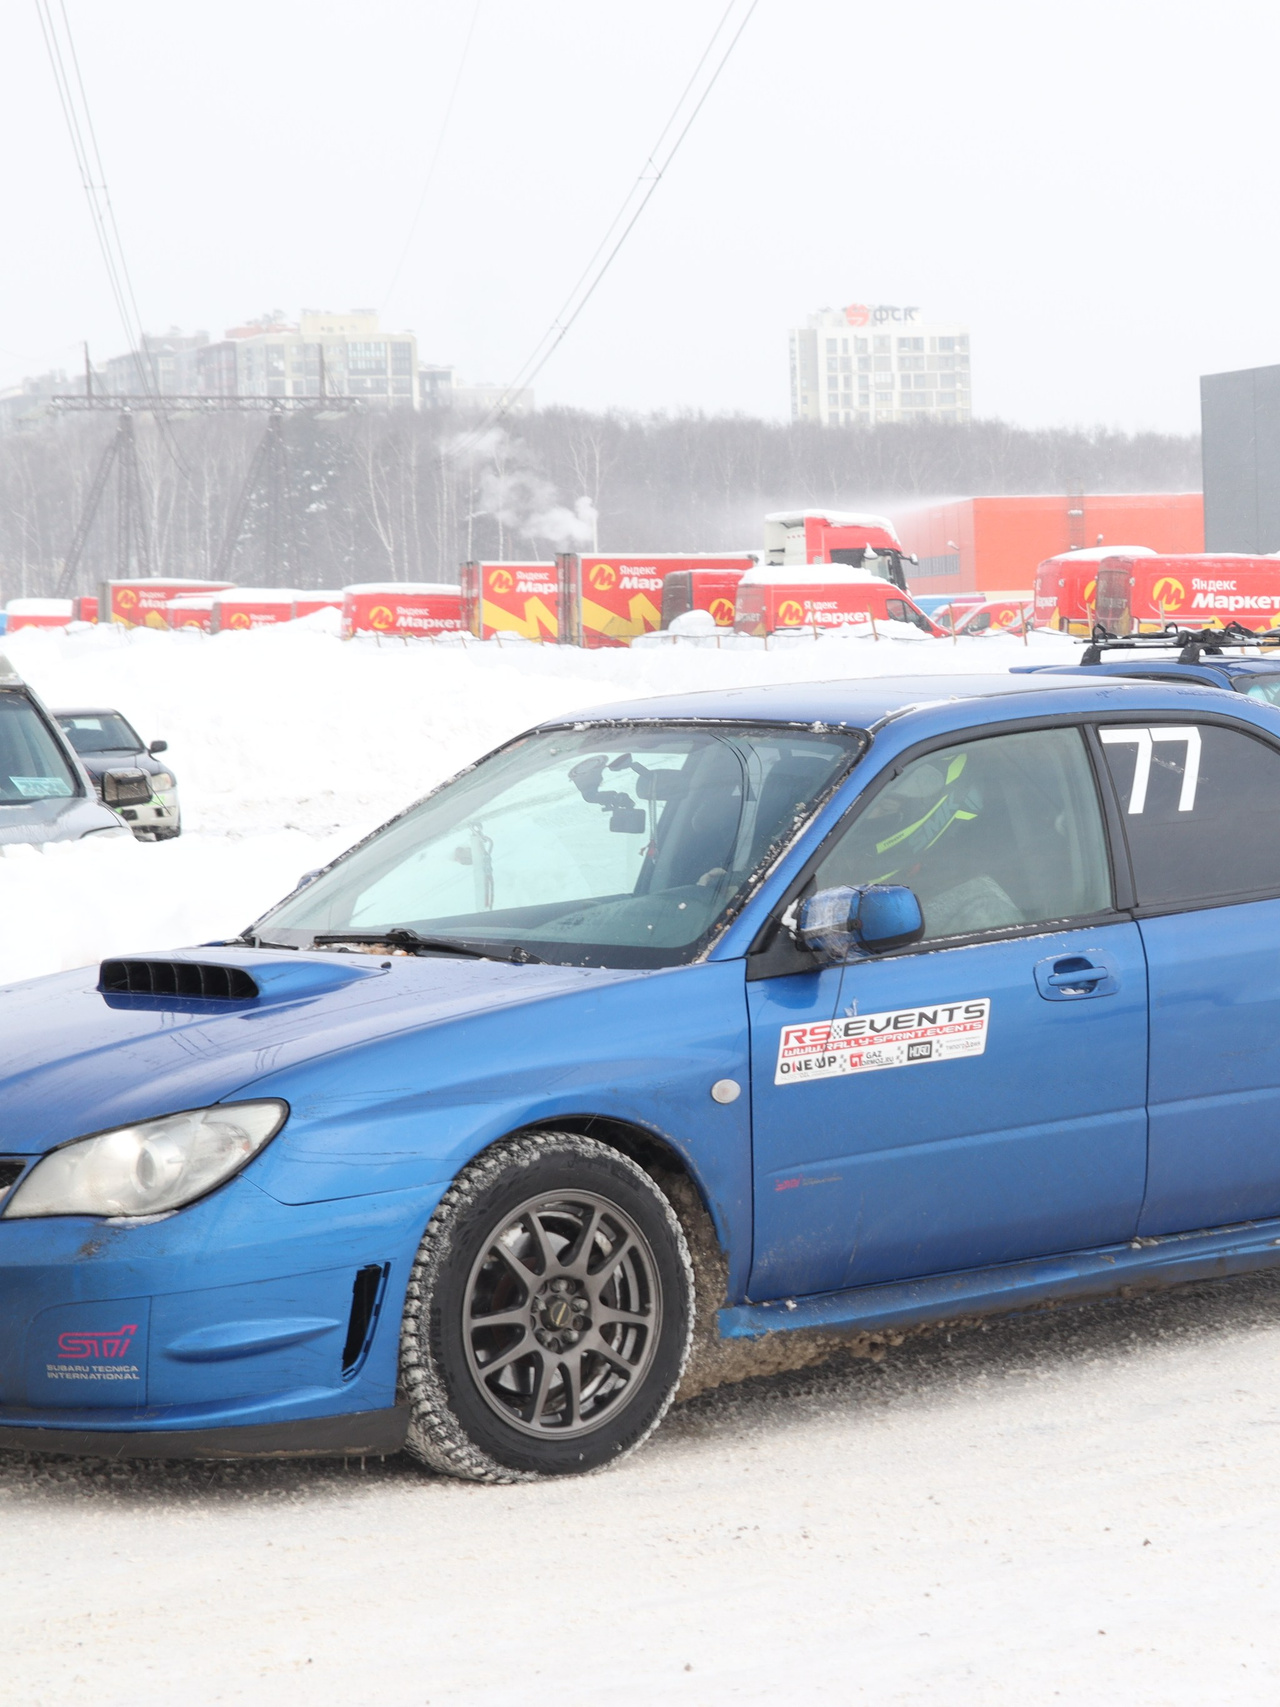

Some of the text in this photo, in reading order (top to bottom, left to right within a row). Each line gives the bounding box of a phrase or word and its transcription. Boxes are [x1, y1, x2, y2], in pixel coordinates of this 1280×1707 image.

[873, 305, 915, 323] ФСК
[516, 571, 549, 581] Яндекс
[619, 565, 657, 576] Яндекс
[516, 582, 558, 594] Мар
[619, 577, 664, 591] Мар
[1191, 578, 1237, 591] Яндекс
[139, 599, 168, 609] Мар
[396, 606, 429, 616] Яндекс
[804, 611, 871, 623] Маркет
[396, 617, 461, 629] Маркет
[1098, 727, 1201, 814] 77
[784, 1003, 985, 1046] RS EVENTS
[782, 1021, 983, 1057] WWW.RALLY-SPRINT.EVENTS
[780, 1059, 812, 1074] ONE
[46, 1364, 139, 1372] SUBARU TECNICA
[46, 1372, 140, 1380] INTERNATIONAL
